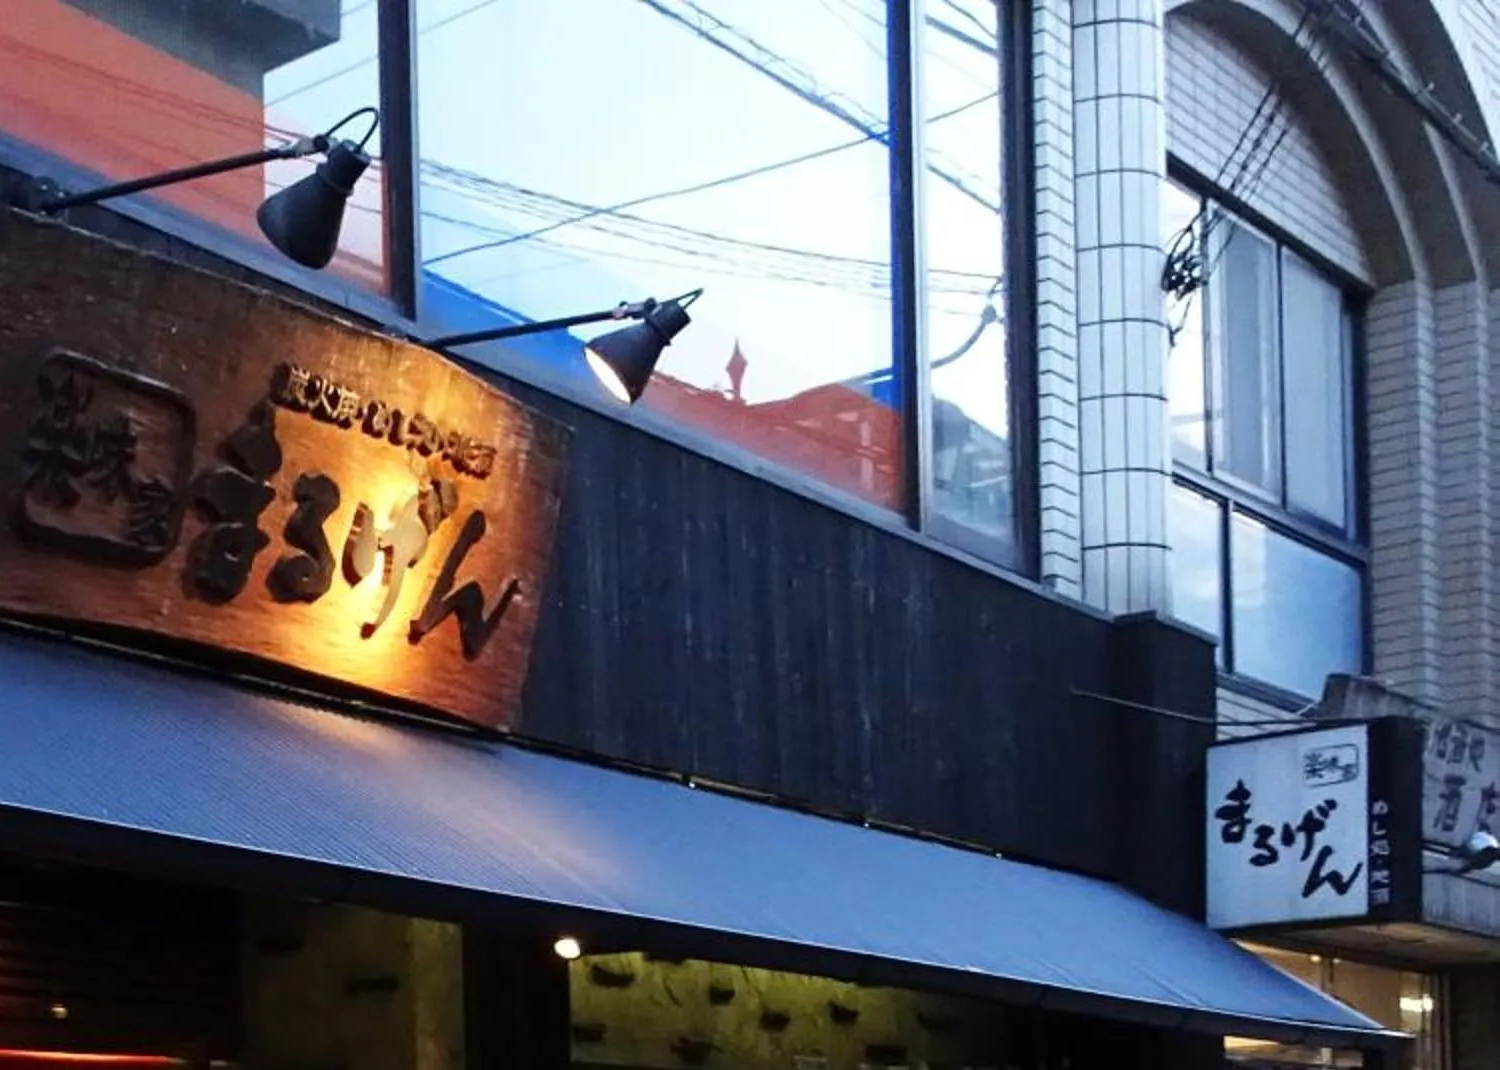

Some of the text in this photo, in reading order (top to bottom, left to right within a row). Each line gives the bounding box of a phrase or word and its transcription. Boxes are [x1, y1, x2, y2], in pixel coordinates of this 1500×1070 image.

[182, 402, 523, 661] まるげん
[1215, 778, 1364, 898] まるげん
